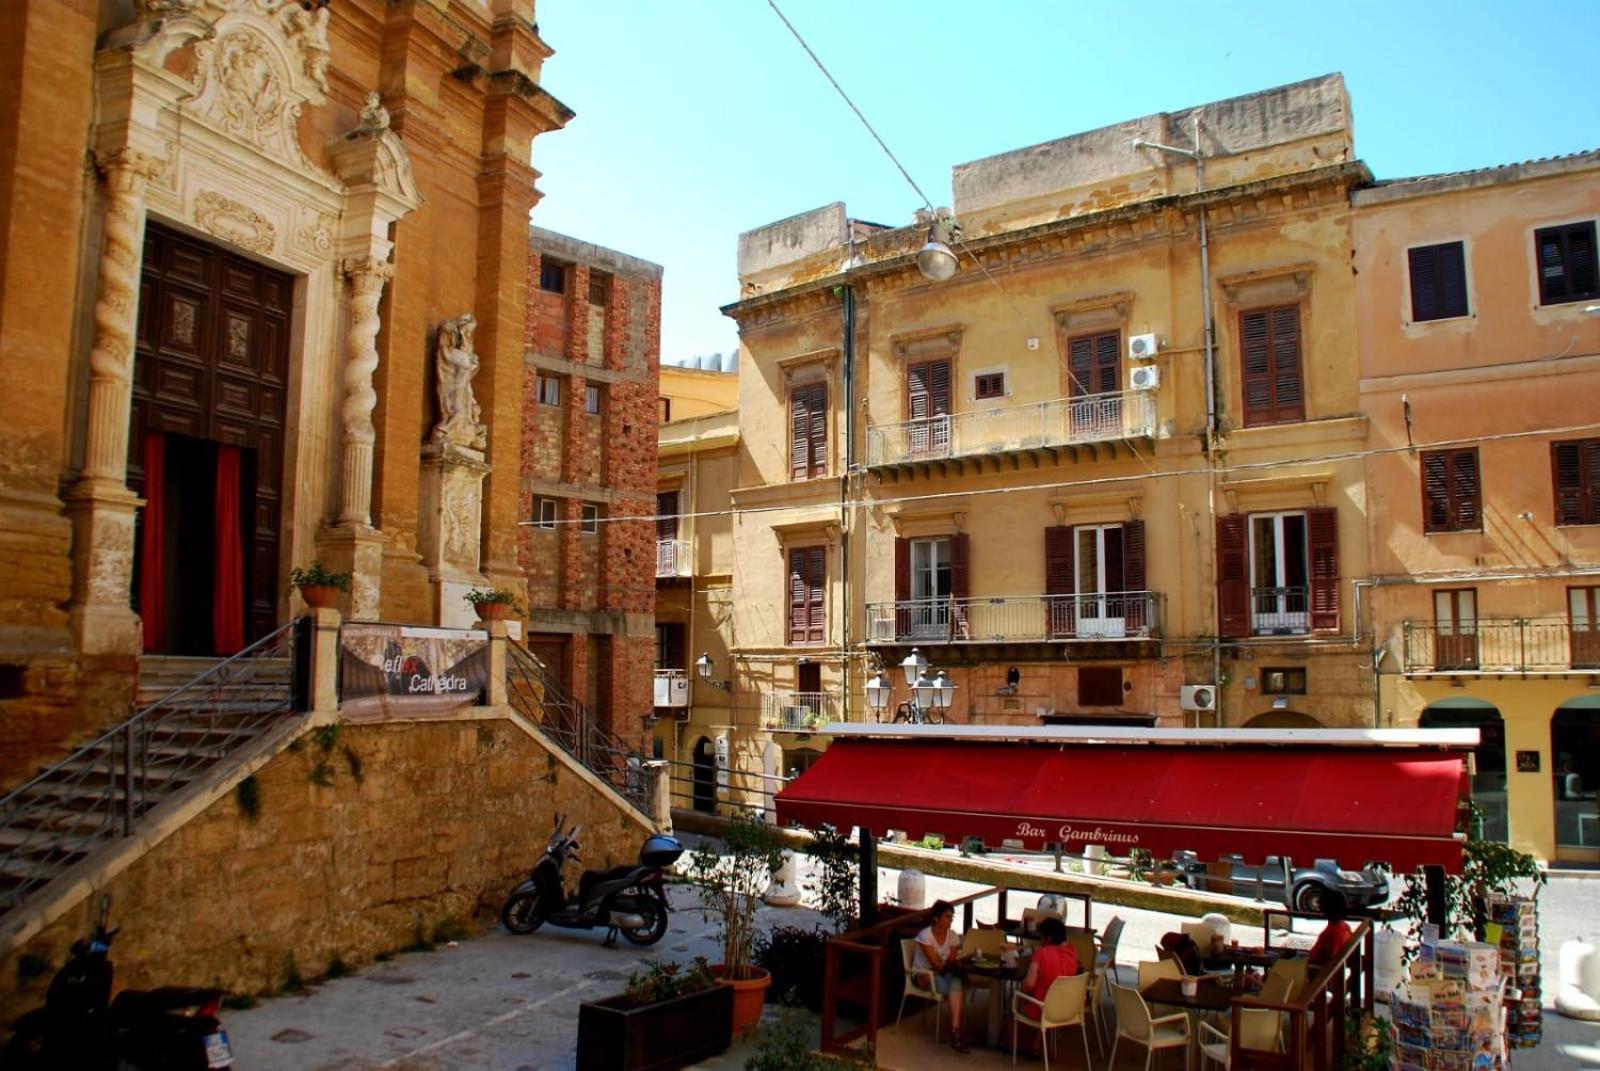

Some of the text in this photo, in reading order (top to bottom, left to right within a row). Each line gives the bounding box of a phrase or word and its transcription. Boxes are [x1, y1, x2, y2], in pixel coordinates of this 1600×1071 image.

[410, 674, 467, 692] Cathedra
[1016, 822, 1140, 843] Bar Gambrinus
